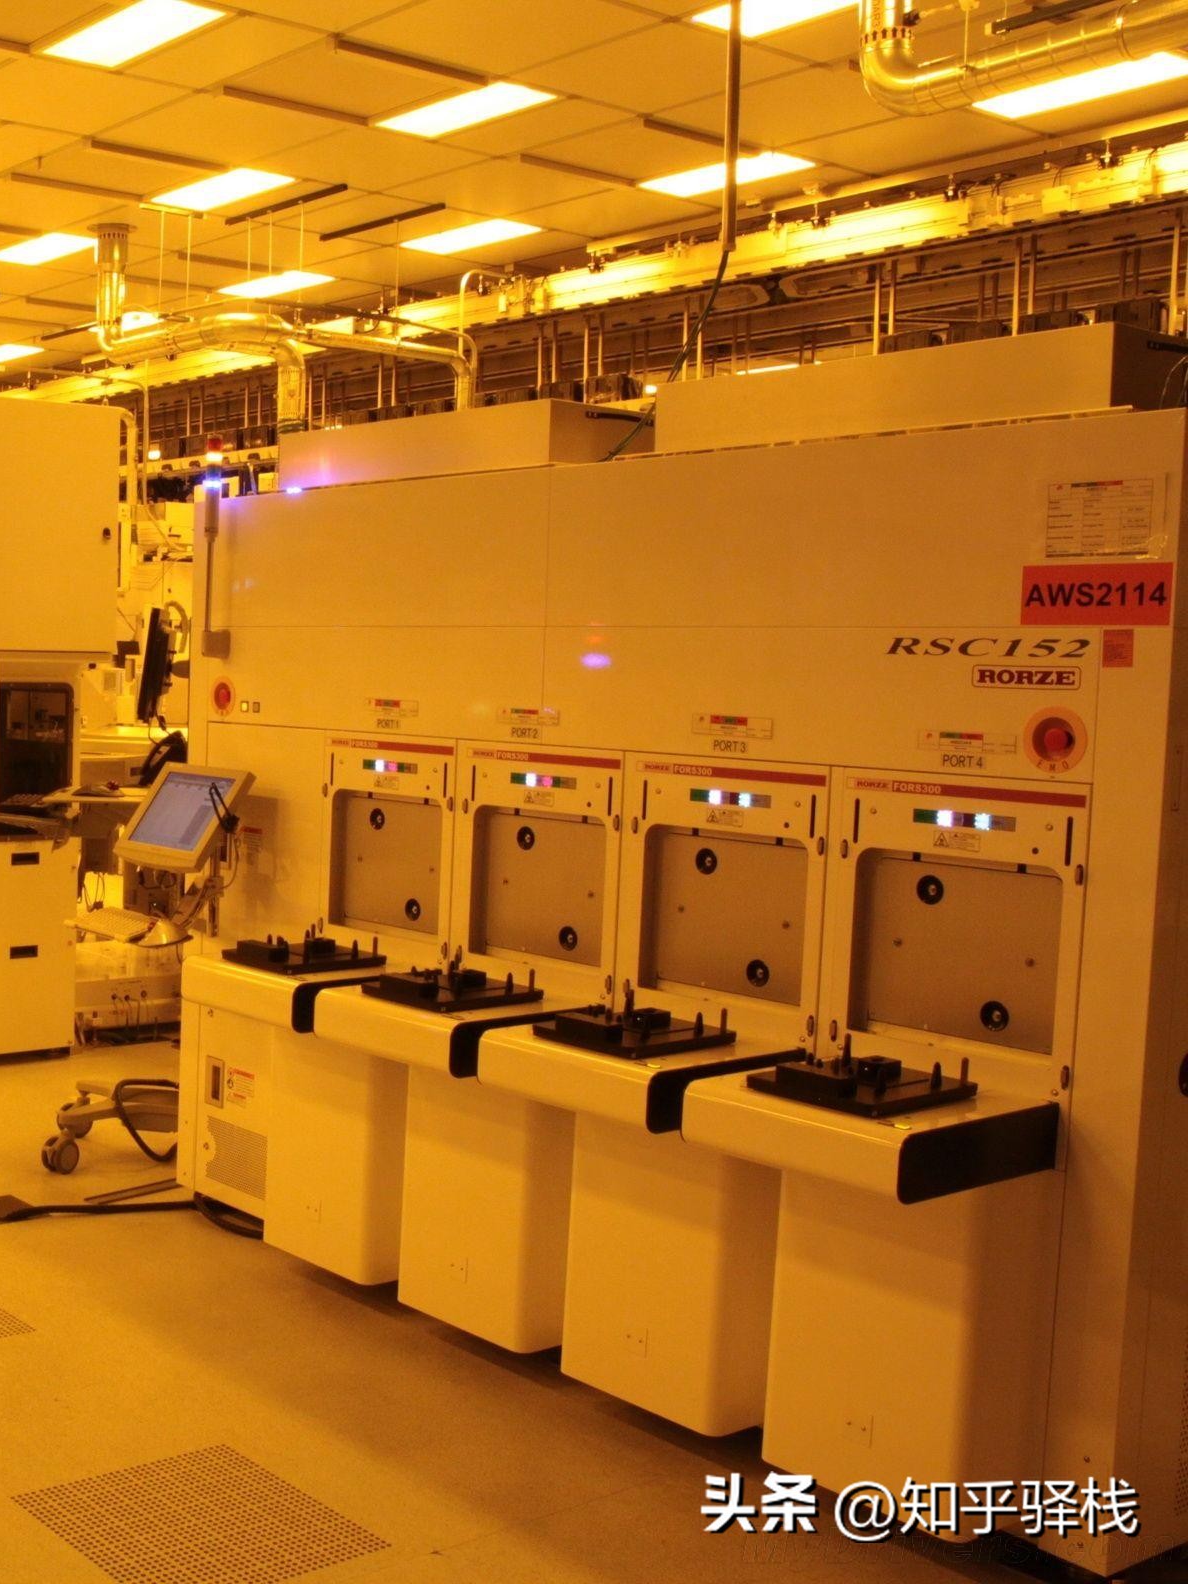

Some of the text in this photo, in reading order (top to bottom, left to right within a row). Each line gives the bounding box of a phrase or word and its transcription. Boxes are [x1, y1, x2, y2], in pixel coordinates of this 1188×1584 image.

[1024, 581, 1167, 608] AWS2114
[886, 637, 1091, 658] RSC152
[976, 668, 1076, 687] RORZE
[376, 718, 394, 729] PORT
[511, 727, 532, 738] PORT
[713, 739, 747, 753] PORT 3
[942, 753, 984, 769] PORT 4
[674, 764, 713, 776] FORS300
[893, 781, 942, 794] FORS300
